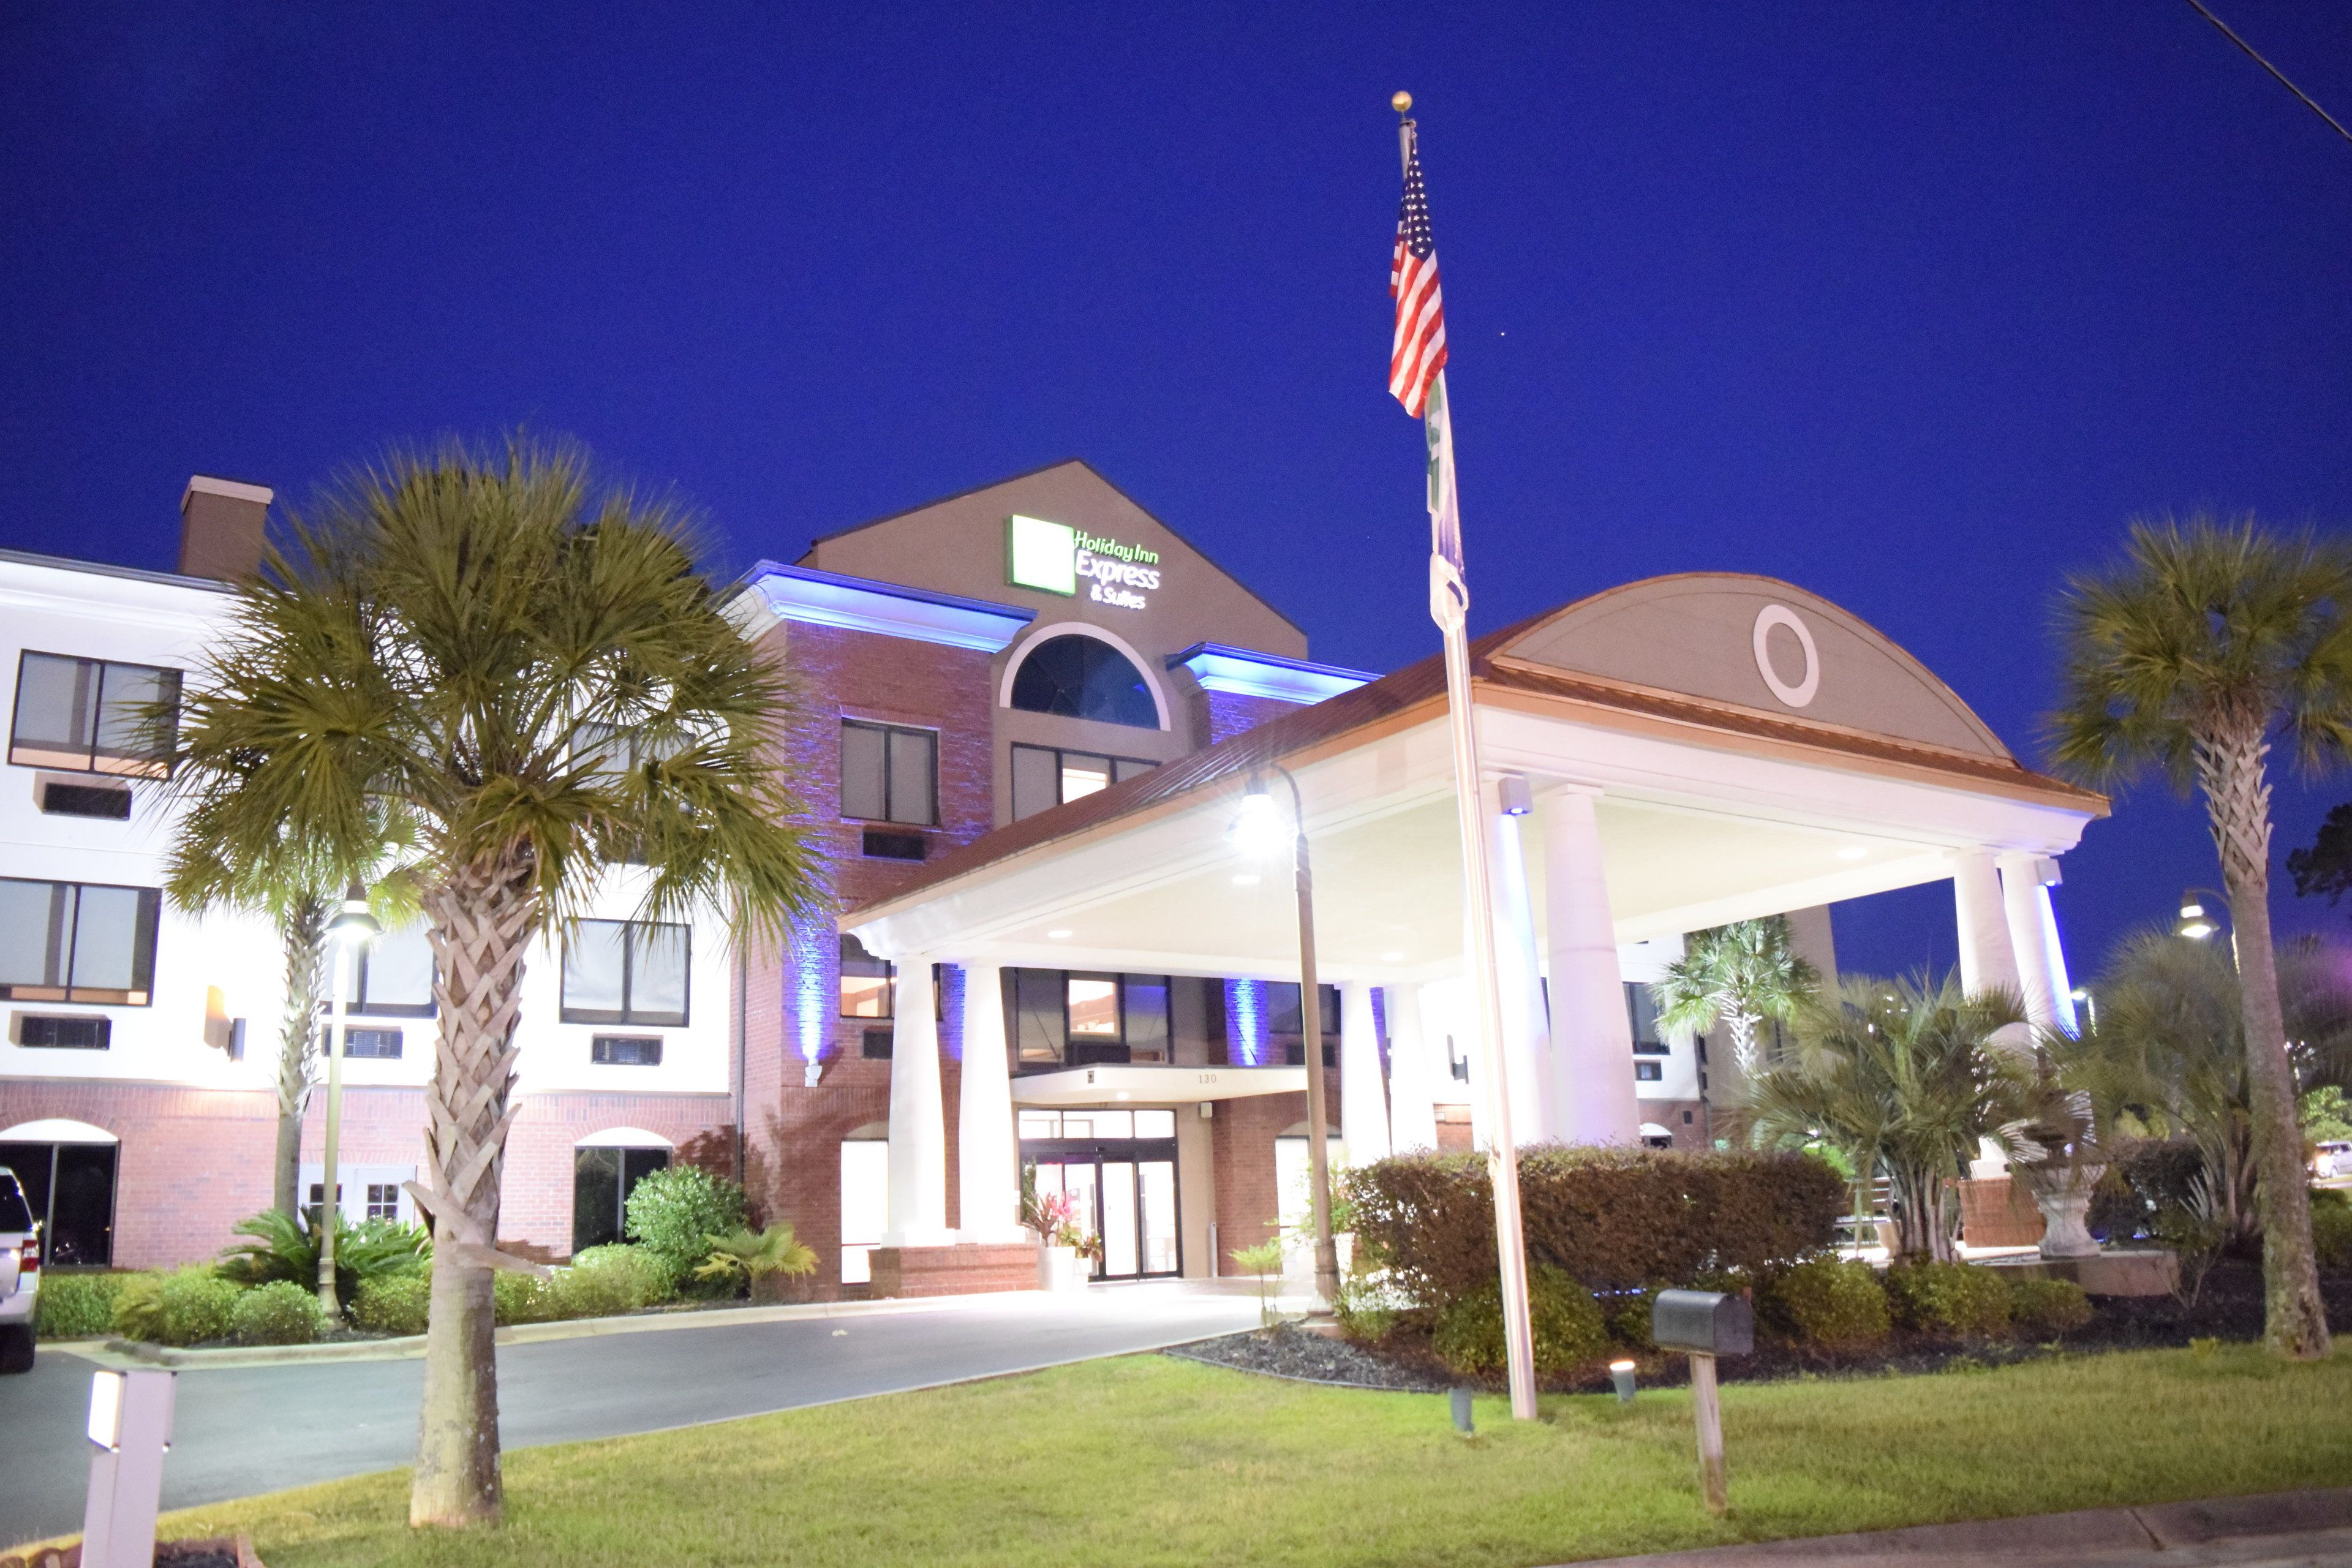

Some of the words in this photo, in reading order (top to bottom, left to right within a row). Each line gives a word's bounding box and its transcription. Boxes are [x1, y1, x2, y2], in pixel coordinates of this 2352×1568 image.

[1074, 530, 1134, 562] Holiday
[1134, 544, 1159, 565] Inn
[1075, 549, 1160, 590] Express
[1090, 584, 1102, 601] &
[1103, 587, 1145, 609] Suites
[1199, 1074, 1217, 1084] 130
